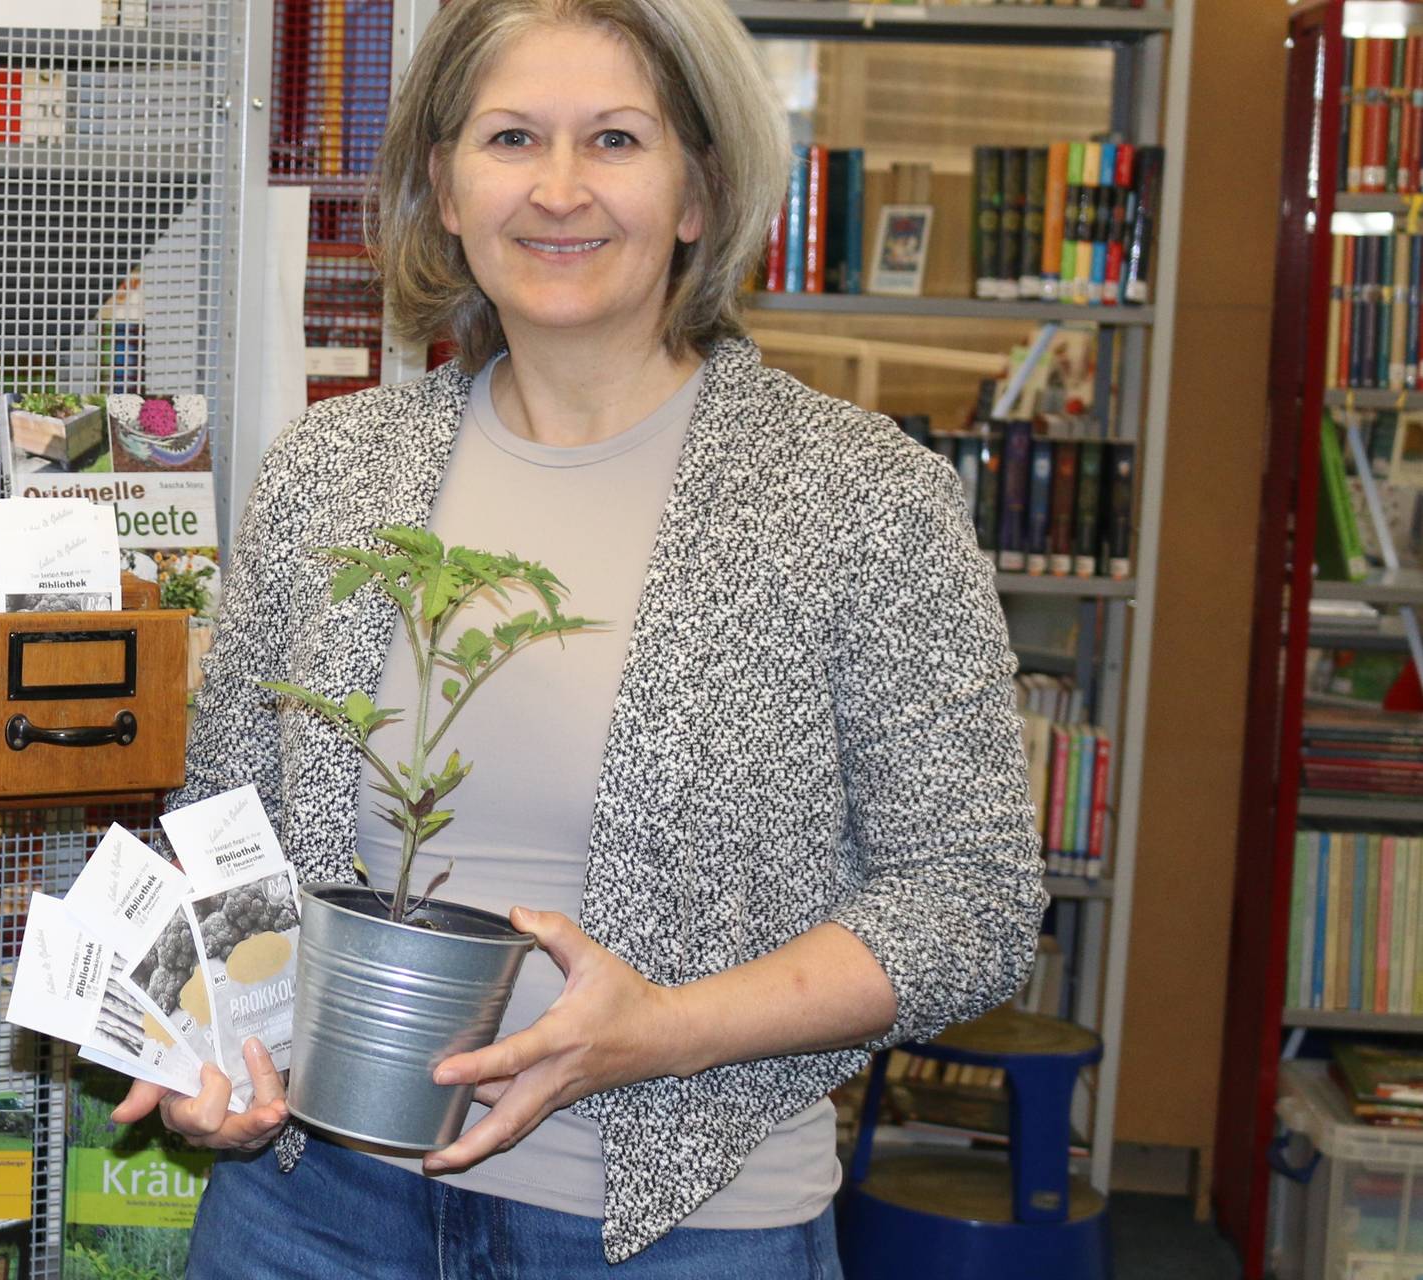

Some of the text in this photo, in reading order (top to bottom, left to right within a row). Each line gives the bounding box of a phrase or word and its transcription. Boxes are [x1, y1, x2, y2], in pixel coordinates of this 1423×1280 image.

[113, 502, 198, 537] beete
[215, 842, 261, 866] Bibliothek
[124, 874, 158, 921] Bibliothek
[75, 941, 95, 998] Bibliothek
[214, 974, 227, 985] BIO
[229, 978, 296, 1016] BROKKOL
[181, 1018, 193, 1033] BIO
[102, 1159, 209, 1198] Kräu
